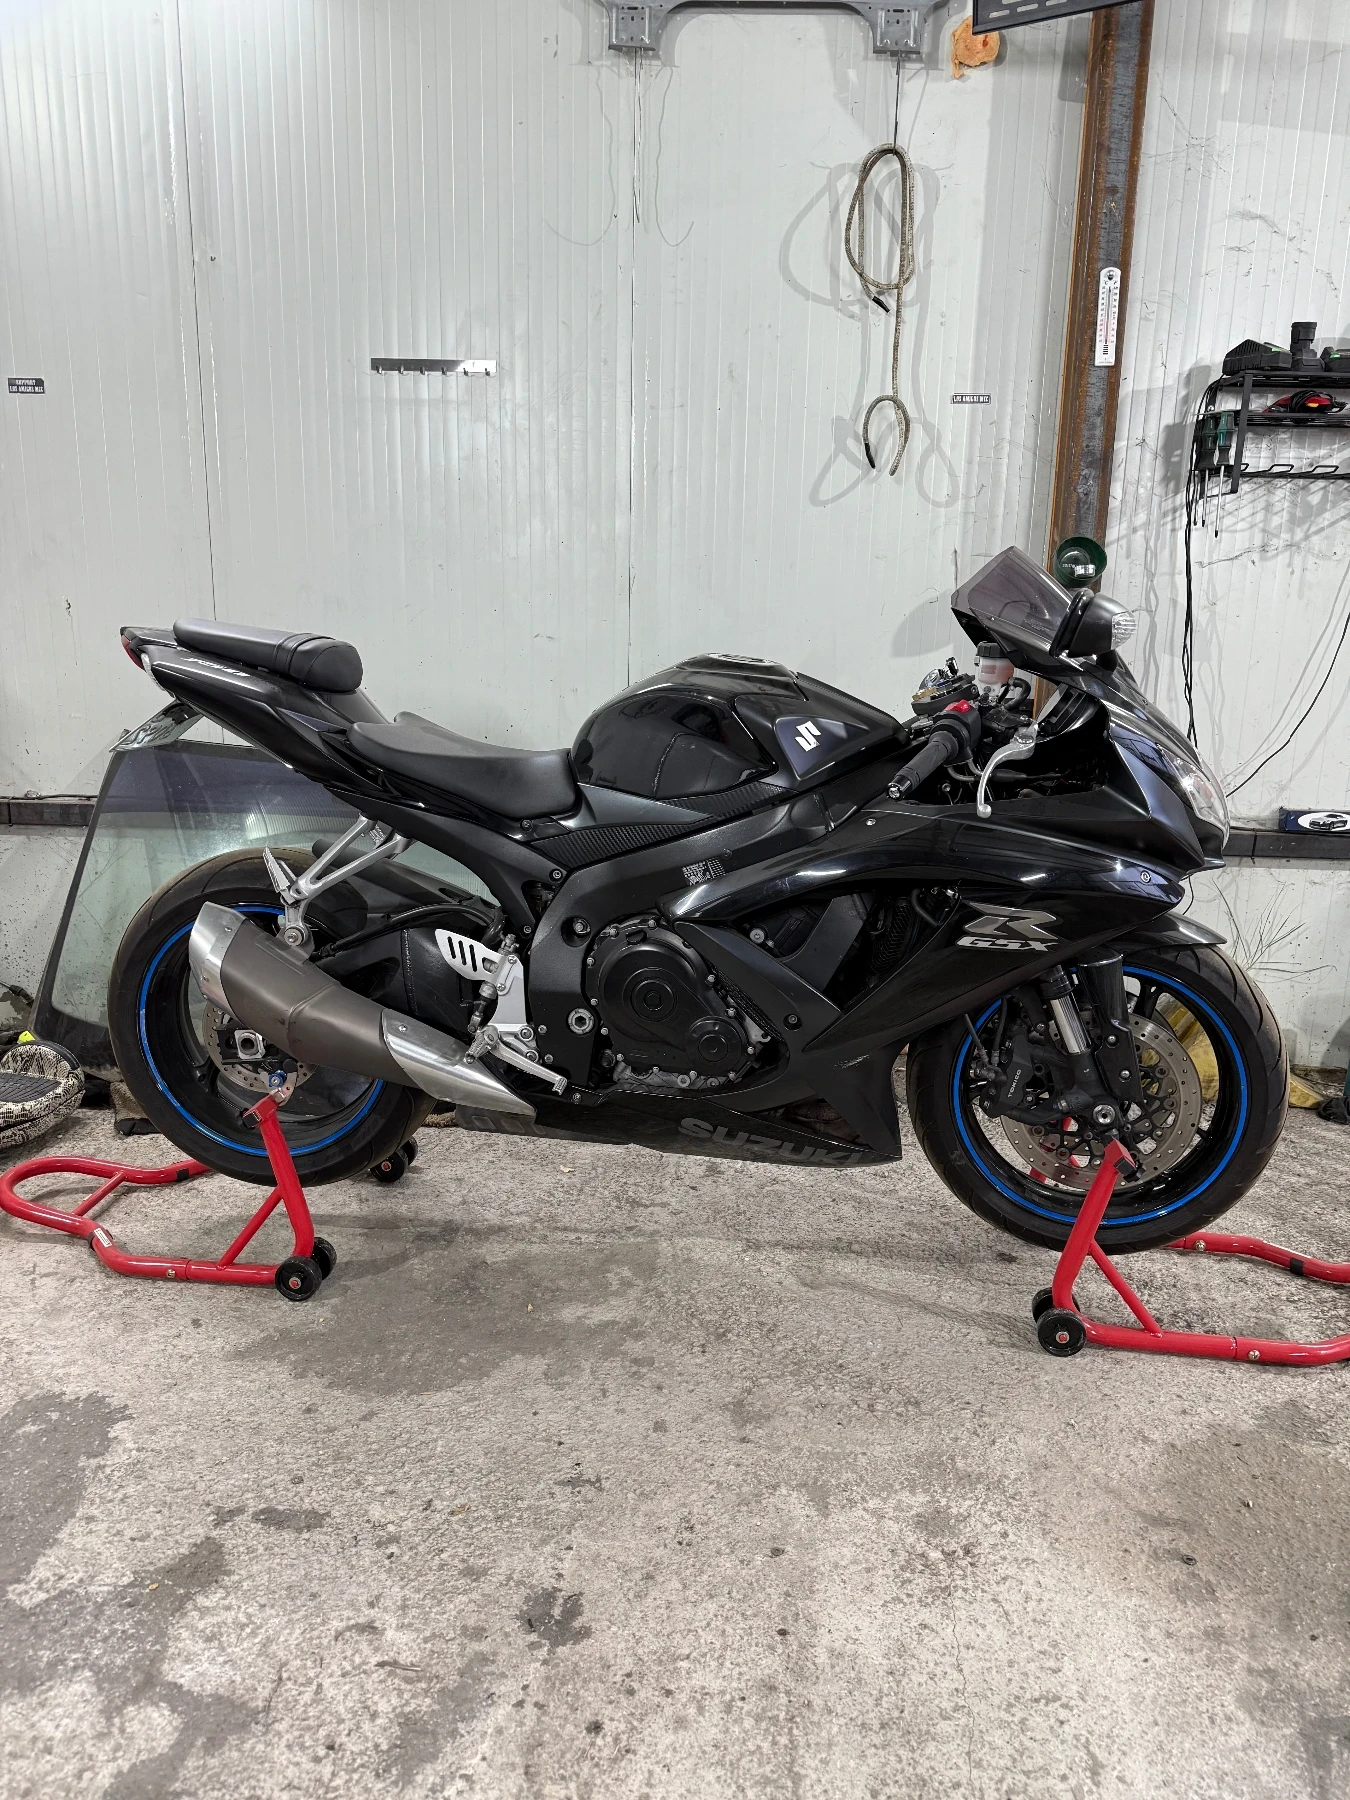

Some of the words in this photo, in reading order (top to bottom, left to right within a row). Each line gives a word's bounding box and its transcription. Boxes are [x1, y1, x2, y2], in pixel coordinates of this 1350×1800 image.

[957, 936, 1059, 952] GSX
[1007, 1069, 1022, 1098] TOKICO
[677, 1117, 863, 1166] SUZUKI
